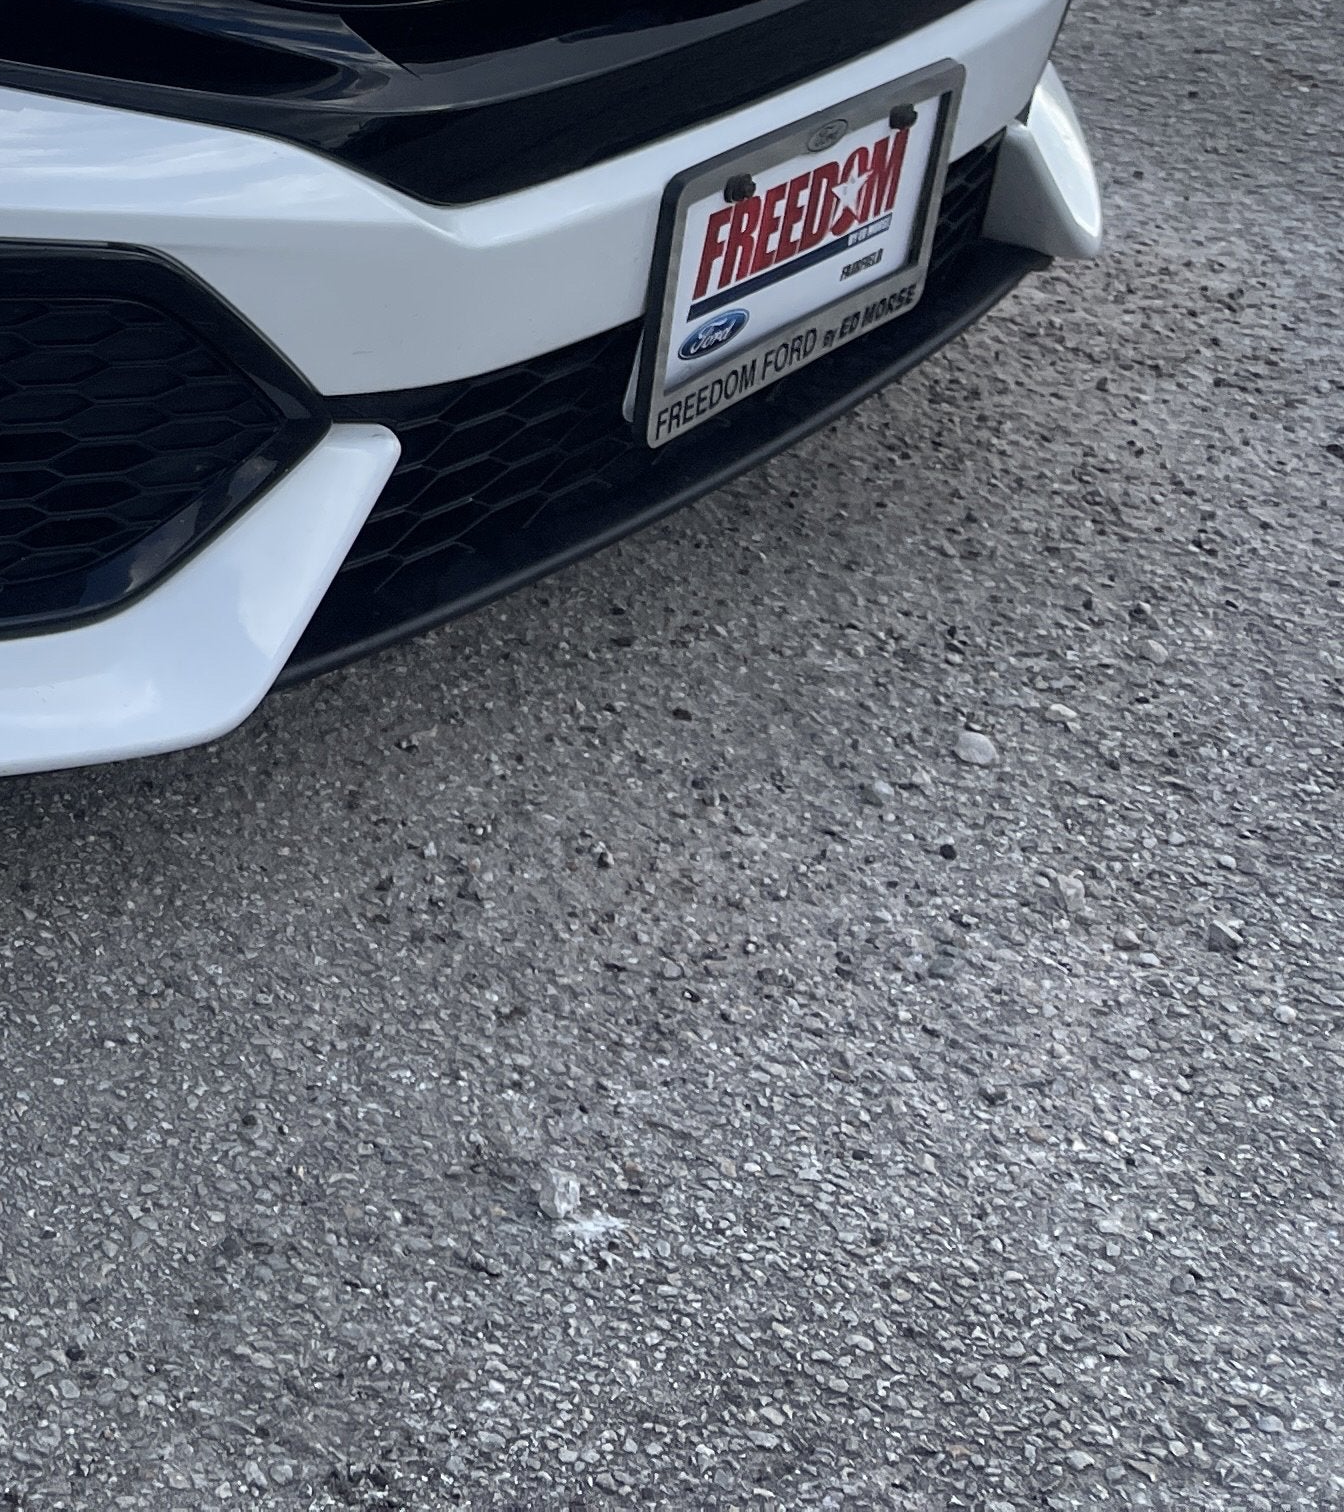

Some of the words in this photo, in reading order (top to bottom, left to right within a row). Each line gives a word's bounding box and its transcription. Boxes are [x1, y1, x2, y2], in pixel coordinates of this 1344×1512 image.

[692, 127, 910, 301] FREEDOM
[655, 359, 757, 441] FREEDOM
[761, 327, 818, 381] FORD
[839, 311, 862, 339] ED
[861, 283, 918, 327] MORSE
[689, 317, 737, 355] Ford
